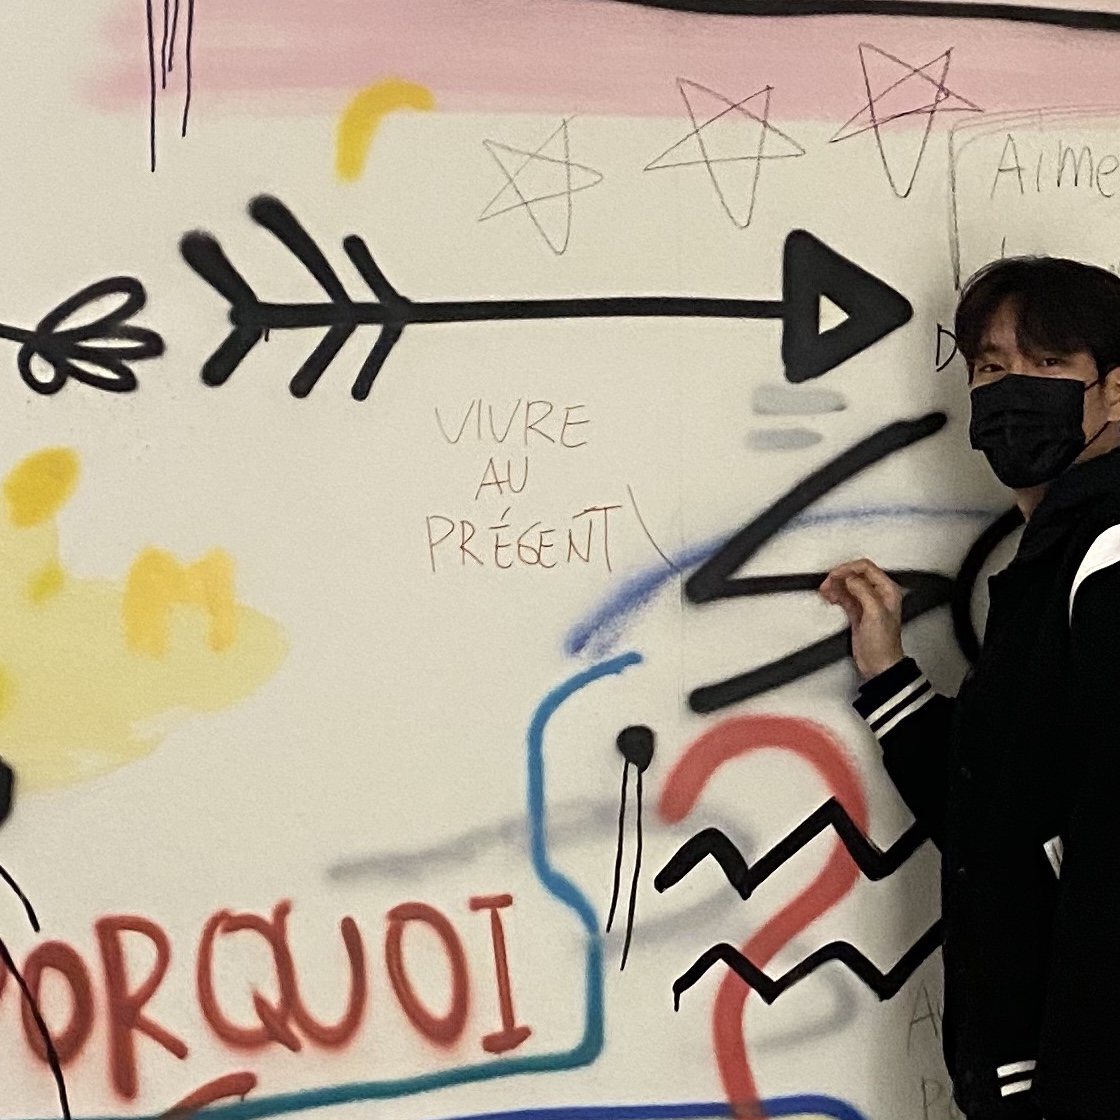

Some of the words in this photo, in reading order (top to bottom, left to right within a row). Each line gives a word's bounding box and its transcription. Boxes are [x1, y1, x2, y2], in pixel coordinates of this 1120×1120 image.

[433, 398, 593, 449] VIVRE
[474, 456, 530, 501] AU
[0, 892, 532, 1102] ORQUOI
